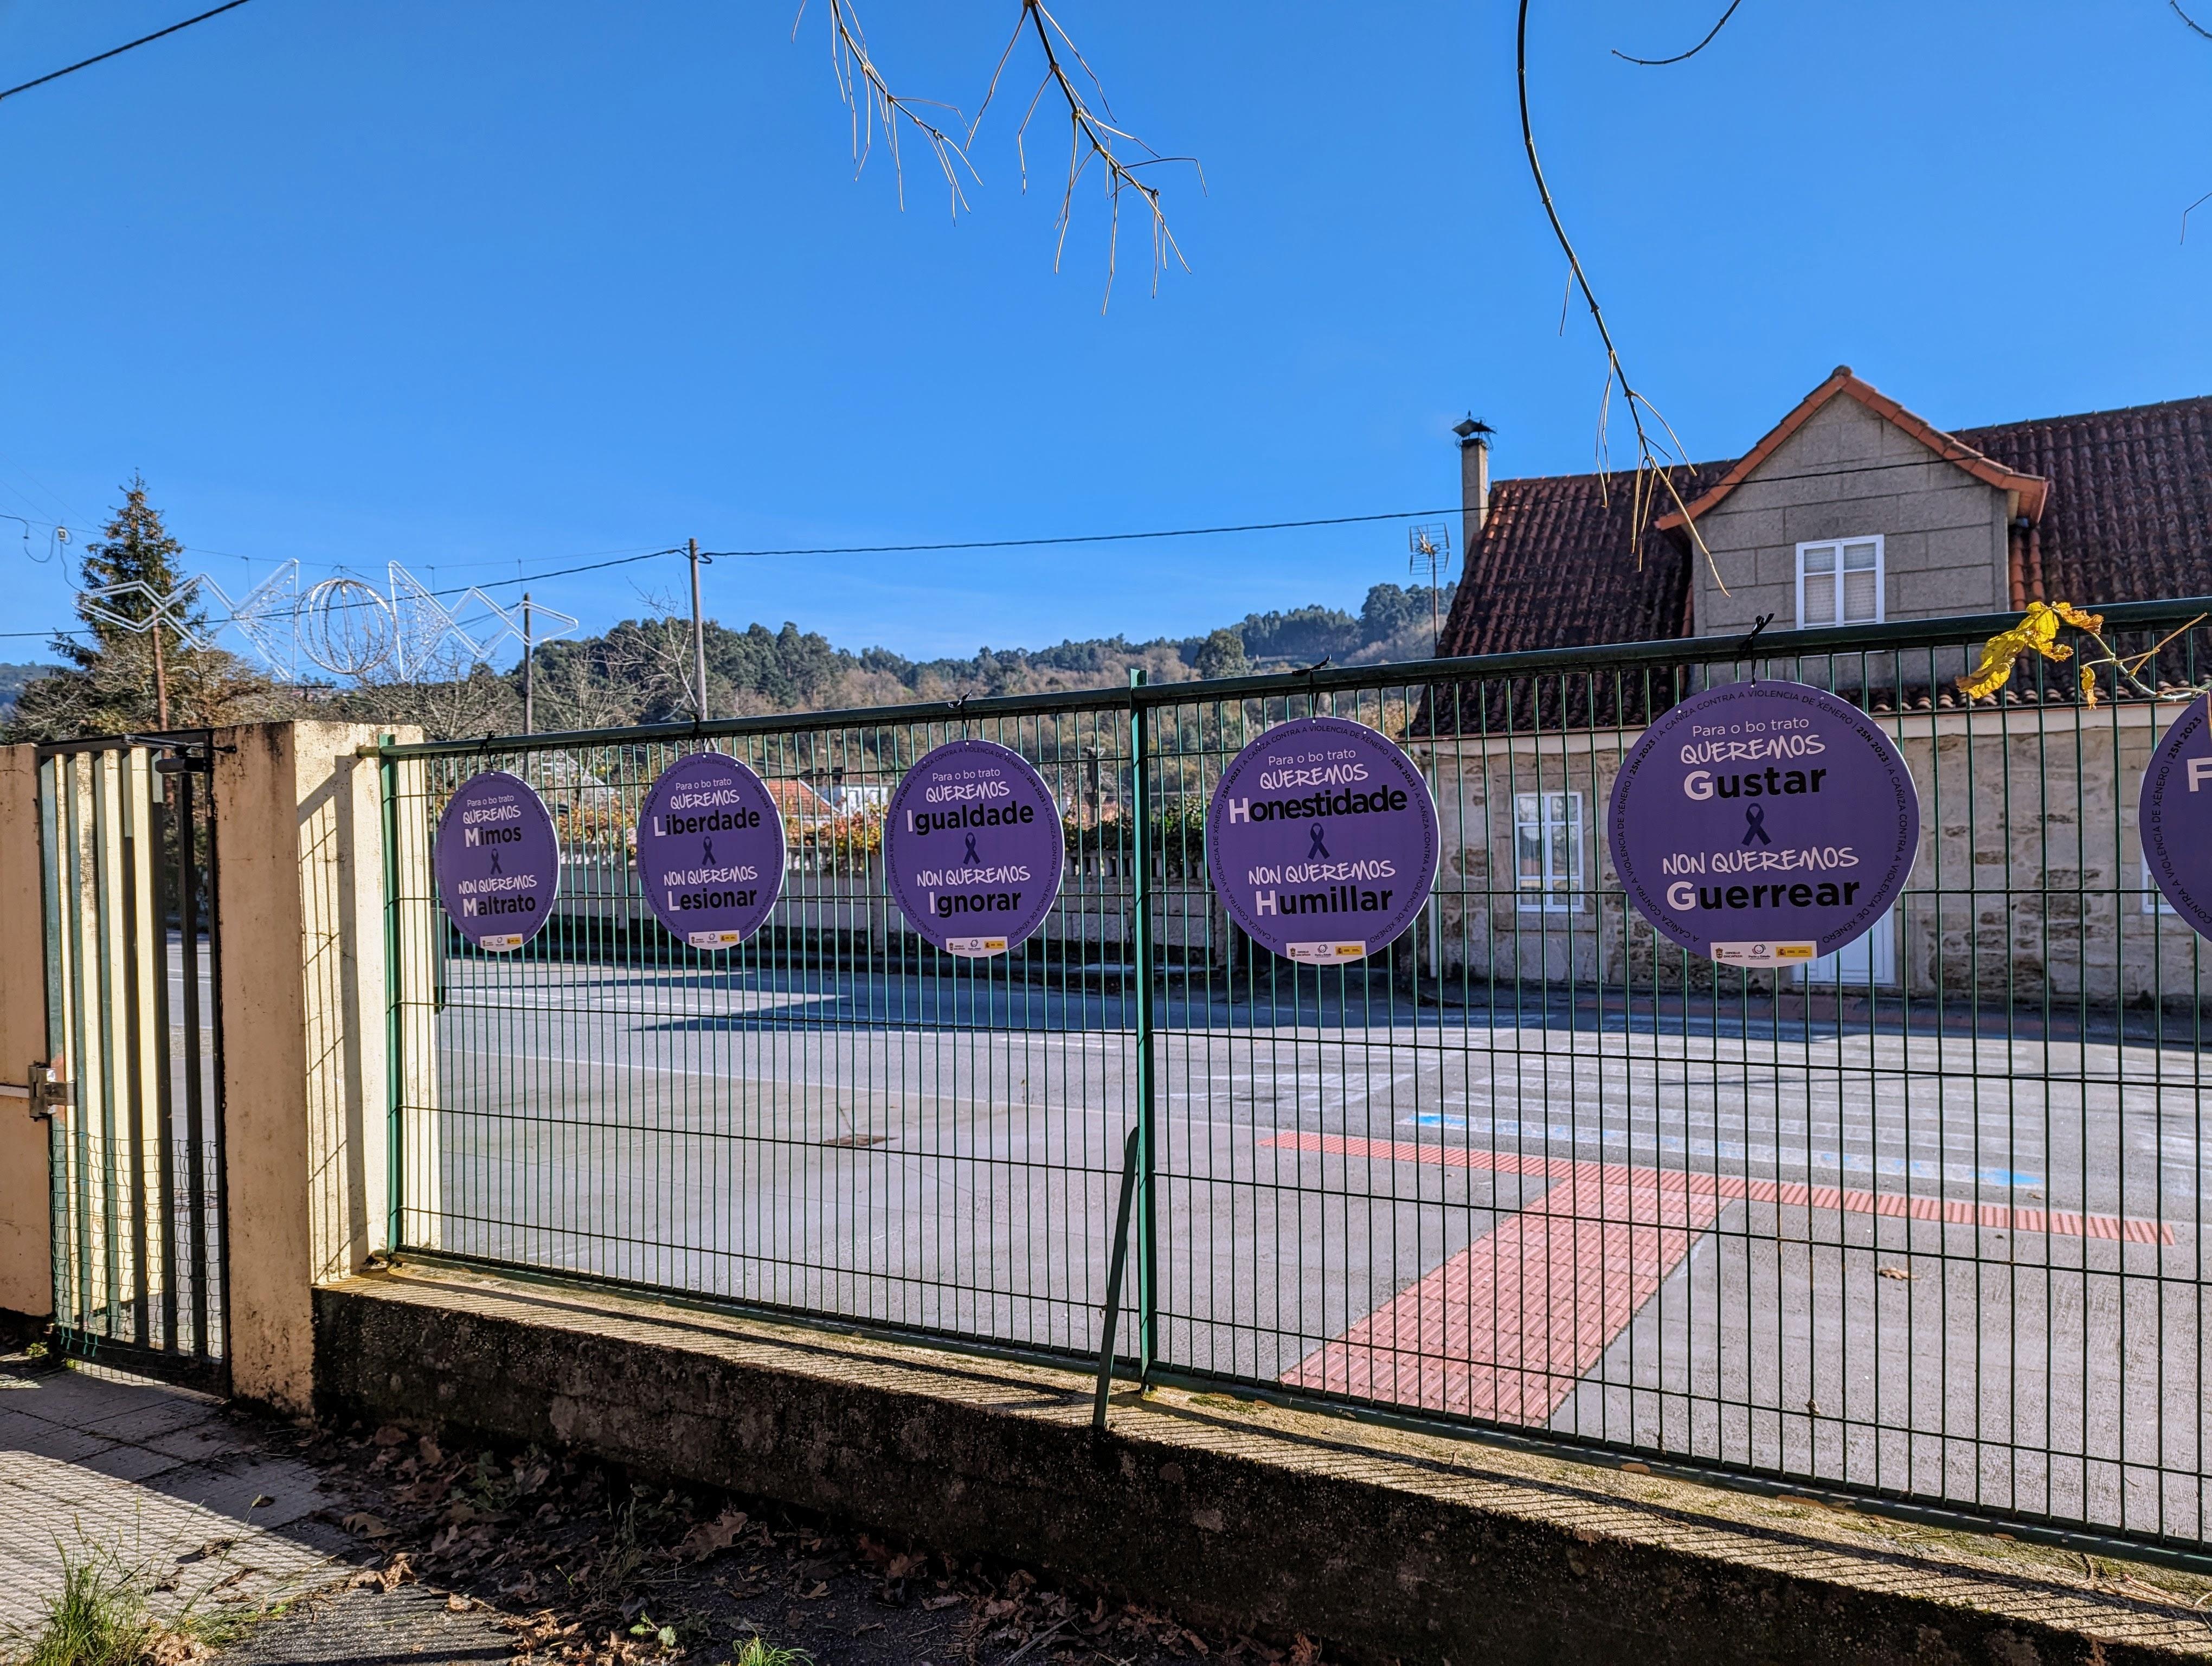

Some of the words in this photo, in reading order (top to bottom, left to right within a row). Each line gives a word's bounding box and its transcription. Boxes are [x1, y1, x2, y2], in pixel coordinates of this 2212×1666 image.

[1697, 694, 1735, 710] CONTRA
[1748, 690, 1798, 701] VIOLENCIA
[1802, 696, 1815, 706] DE
[1271, 728, 1300, 743] CONTRA
[1309, 725, 1348, 735] VIOLENCIA
[1349, 731, 1360, 739] DE
[1693, 725, 1725, 738] Para
[1731, 726, 1740, 734] o
[1746, 721, 1766, 733] bo
[1771, 717, 1809, 731] trato
[1856, 727, 1873, 742] 25N
[2180, 716, 2202, 739] 2023
[1269, 755, 1295, 766] Para
[1297, 755, 1304, 764] o
[1308, 752, 1323, 762] bo
[1327, 749, 1356, 760] trato
[1639, 739, 1655, 759] 2023
[1681, 734, 1826, 765] QUEREMOS
[1870, 742, 1889, 762] 2023
[2168, 740, 2183, 759] 25N
[1391, 757, 1404, 770] 25N
[1629, 759, 1642, 775] 25N
[701, 779, 711, 788] bo
[713, 778, 732, 787] trato
[933, 772, 952, 782] Para
[963, 770, 975, 779] bo
[978, 768, 1000, 778] trato
[1229, 768, 1241, 785] 2023
[1260, 764, 1369, 790] QUEREMOS
[1401, 770, 1416, 787] 2023
[1684, 767, 1827, 800] Gustar
[467, 799, 481, 807] Para
[488, 796, 497, 804] bo
[671, 790, 740, 809] QUEREMOS
[926, 781, 1010, 803] QUEREMOS
[1221, 785, 1231, 799] 25N
[463, 805, 521, 824] QUEREMOS
[1229, 785, 1407, 824] Honestidade
[653, 807, 760, 836] Liberdade
[906, 800, 1034, 836] Igualdade
[1617, 818, 1624, 829] DE
[2152, 810, 2161, 823] DE
[465, 826, 522, 847] Mimos
[1213, 836, 1219, 845] DE
[1896, 814, 1907, 852] CONTRA
[1618, 831, 1634, 876] VIOLENCIA
[1663, 853, 1706, 875] NON
[1712, 847, 1859, 873] QUEREMOS
[2153, 826, 2175, 879] VIOLENCIA
[664, 871, 686, 886] NON
[688, 867, 758, 885] QUEREMOS
[917, 870, 942, 887] NON
[946, 866, 1031, 886] QUEREMOS
[1214, 848, 1227, 887] VIOLENCIA
[1249, 866, 1281, 885] NON
[1285, 861, 1396, 882] QUEREMOS
[458, 880, 477, 895] NON
[479, 875, 537, 891] QUEREMOS
[1402, 875, 1425, 912] VIOLENCIA
[1867, 865, 1899, 907] VIOLENCIA
[463, 894, 536, 917] Maltrato
[668, 888, 757, 911] Lesionar
[929, 891, 1021, 918] Ignorar
[1256, 886, 1393, 916] Humillar
[1636, 885, 1661, 915] CONTRA
[1667, 881, 1860, 911] Guerrear
[1229, 894, 1248, 920] CONTRA
[1394, 912, 1405, 922] DE
[1856, 908, 1870, 920] DE
